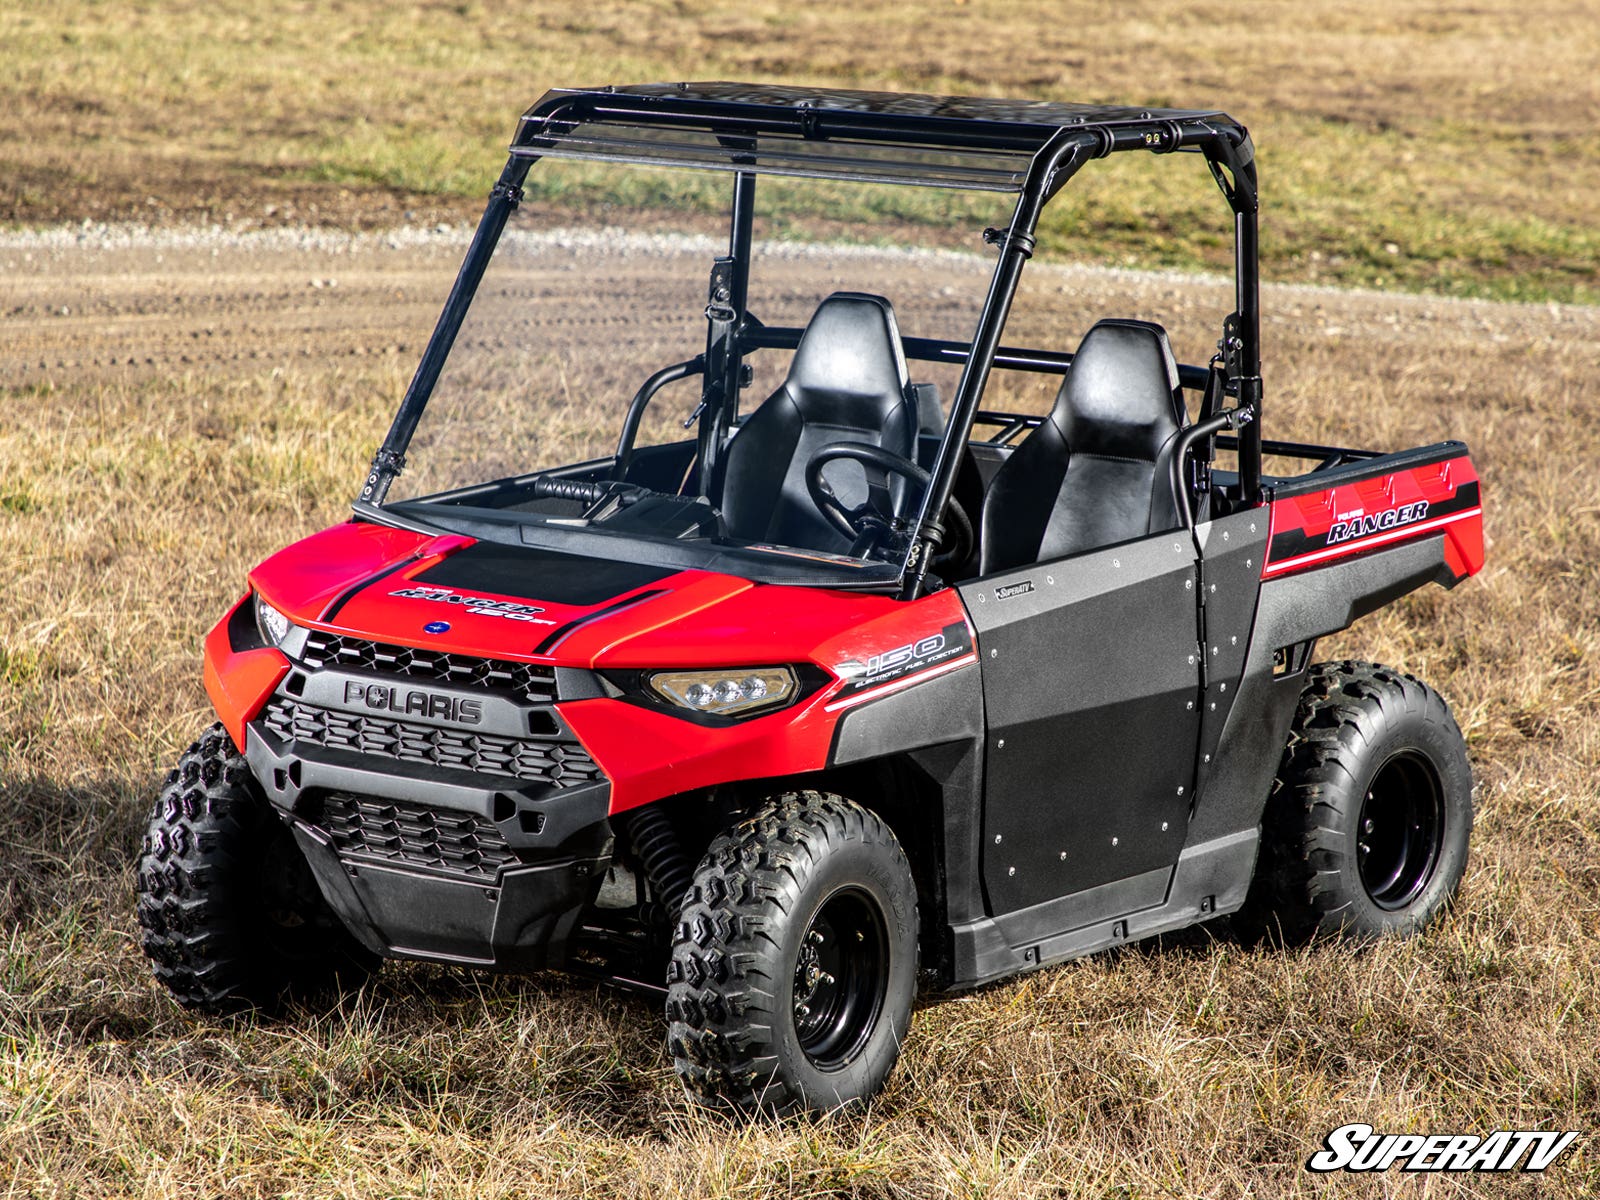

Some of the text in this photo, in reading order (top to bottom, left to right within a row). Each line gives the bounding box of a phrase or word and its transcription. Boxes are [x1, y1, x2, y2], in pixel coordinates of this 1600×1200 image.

[1327, 500, 1429, 544] RANGER
[388, 589, 545, 615] RANGER
[466, 607, 534, 621] 150
[866, 634, 945, 677] 150
[905, 660, 925, 670] FUEL
[927, 645, 963, 663] INJECTION
[344, 680, 482, 724] POLARIS
